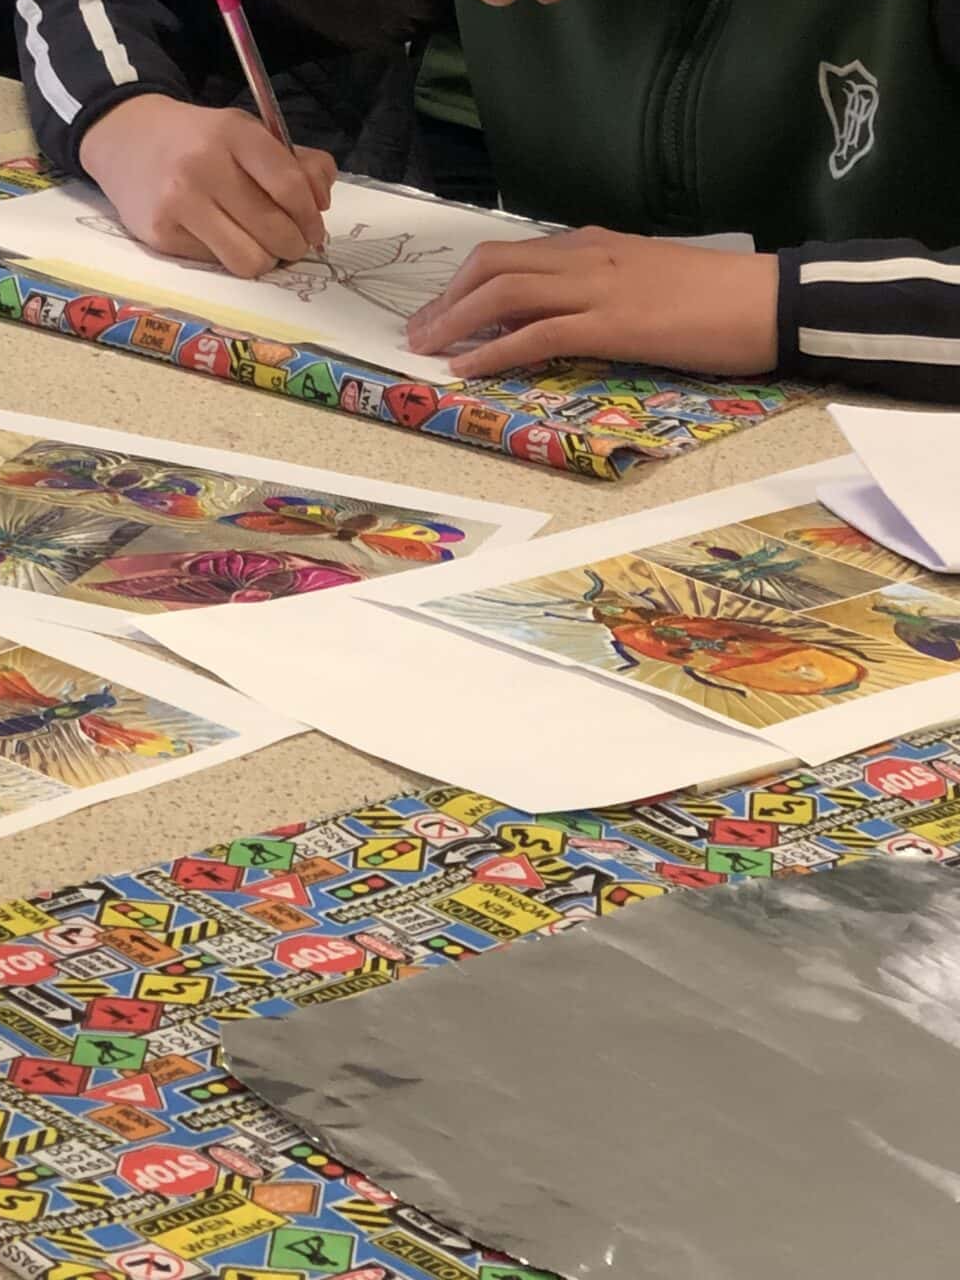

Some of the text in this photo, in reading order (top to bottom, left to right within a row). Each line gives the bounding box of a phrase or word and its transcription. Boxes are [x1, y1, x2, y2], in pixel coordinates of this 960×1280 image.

[144, 318, 171, 333] WORK
[140, 334, 166, 349] ZONE
[879, 766, 938, 794] STOP
[308, 835, 334, 853] NOT
[320, 827, 354, 850] PASS
[626, 826, 700, 863] CAUTION
[478, 900, 516, 919] MEN
[479, 884, 550, 919] WORKING
[438, 900, 518, 938] CAUTION
[217, 940, 251, 955] NOT
[225, 949, 270, 964] PASS
[289, 941, 357, 969] STOP
[300, 975, 387, 1006] CAUTION
[160, 1032, 193, 1051] NOT
[175, 1025, 215, 1047] PASS
[20, 1099, 111, 1152] CONSTRUCTION
[55, 1149, 91, 1167] NOT
[65, 1157, 111, 1178] PASS
[134, 1154, 211, 1189] STOP
[108, 1192, 164, 1216] UNDER
[140, 1195, 242, 1237] CAUTION
[187, 1217, 233, 1235] MEN
[182, 1219, 277, 1255] WORKING
[3, 1244, 45, 1275] PASS
